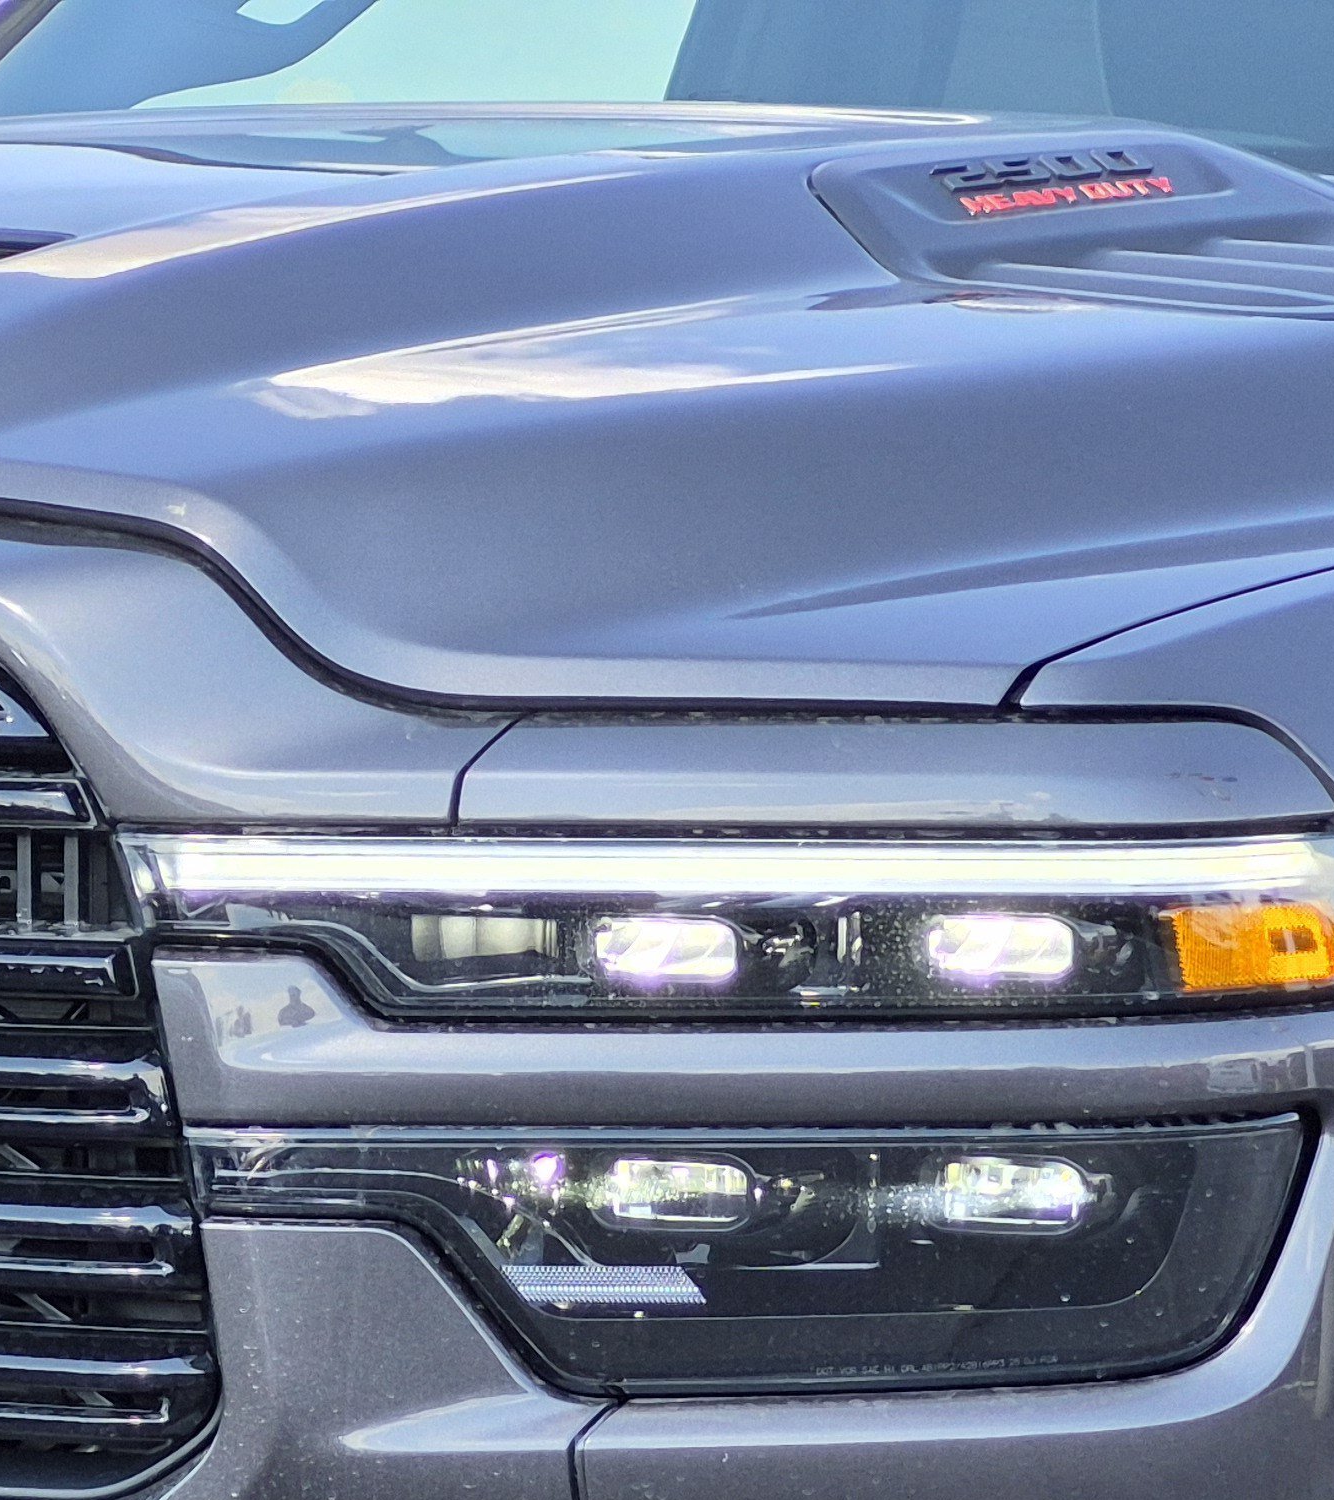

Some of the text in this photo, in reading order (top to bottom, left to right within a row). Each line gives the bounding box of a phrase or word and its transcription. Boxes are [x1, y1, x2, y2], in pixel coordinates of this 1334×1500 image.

[930, 149, 1155, 192] 2500
[960, 176, 1173, 216] HEAVY DUTY
